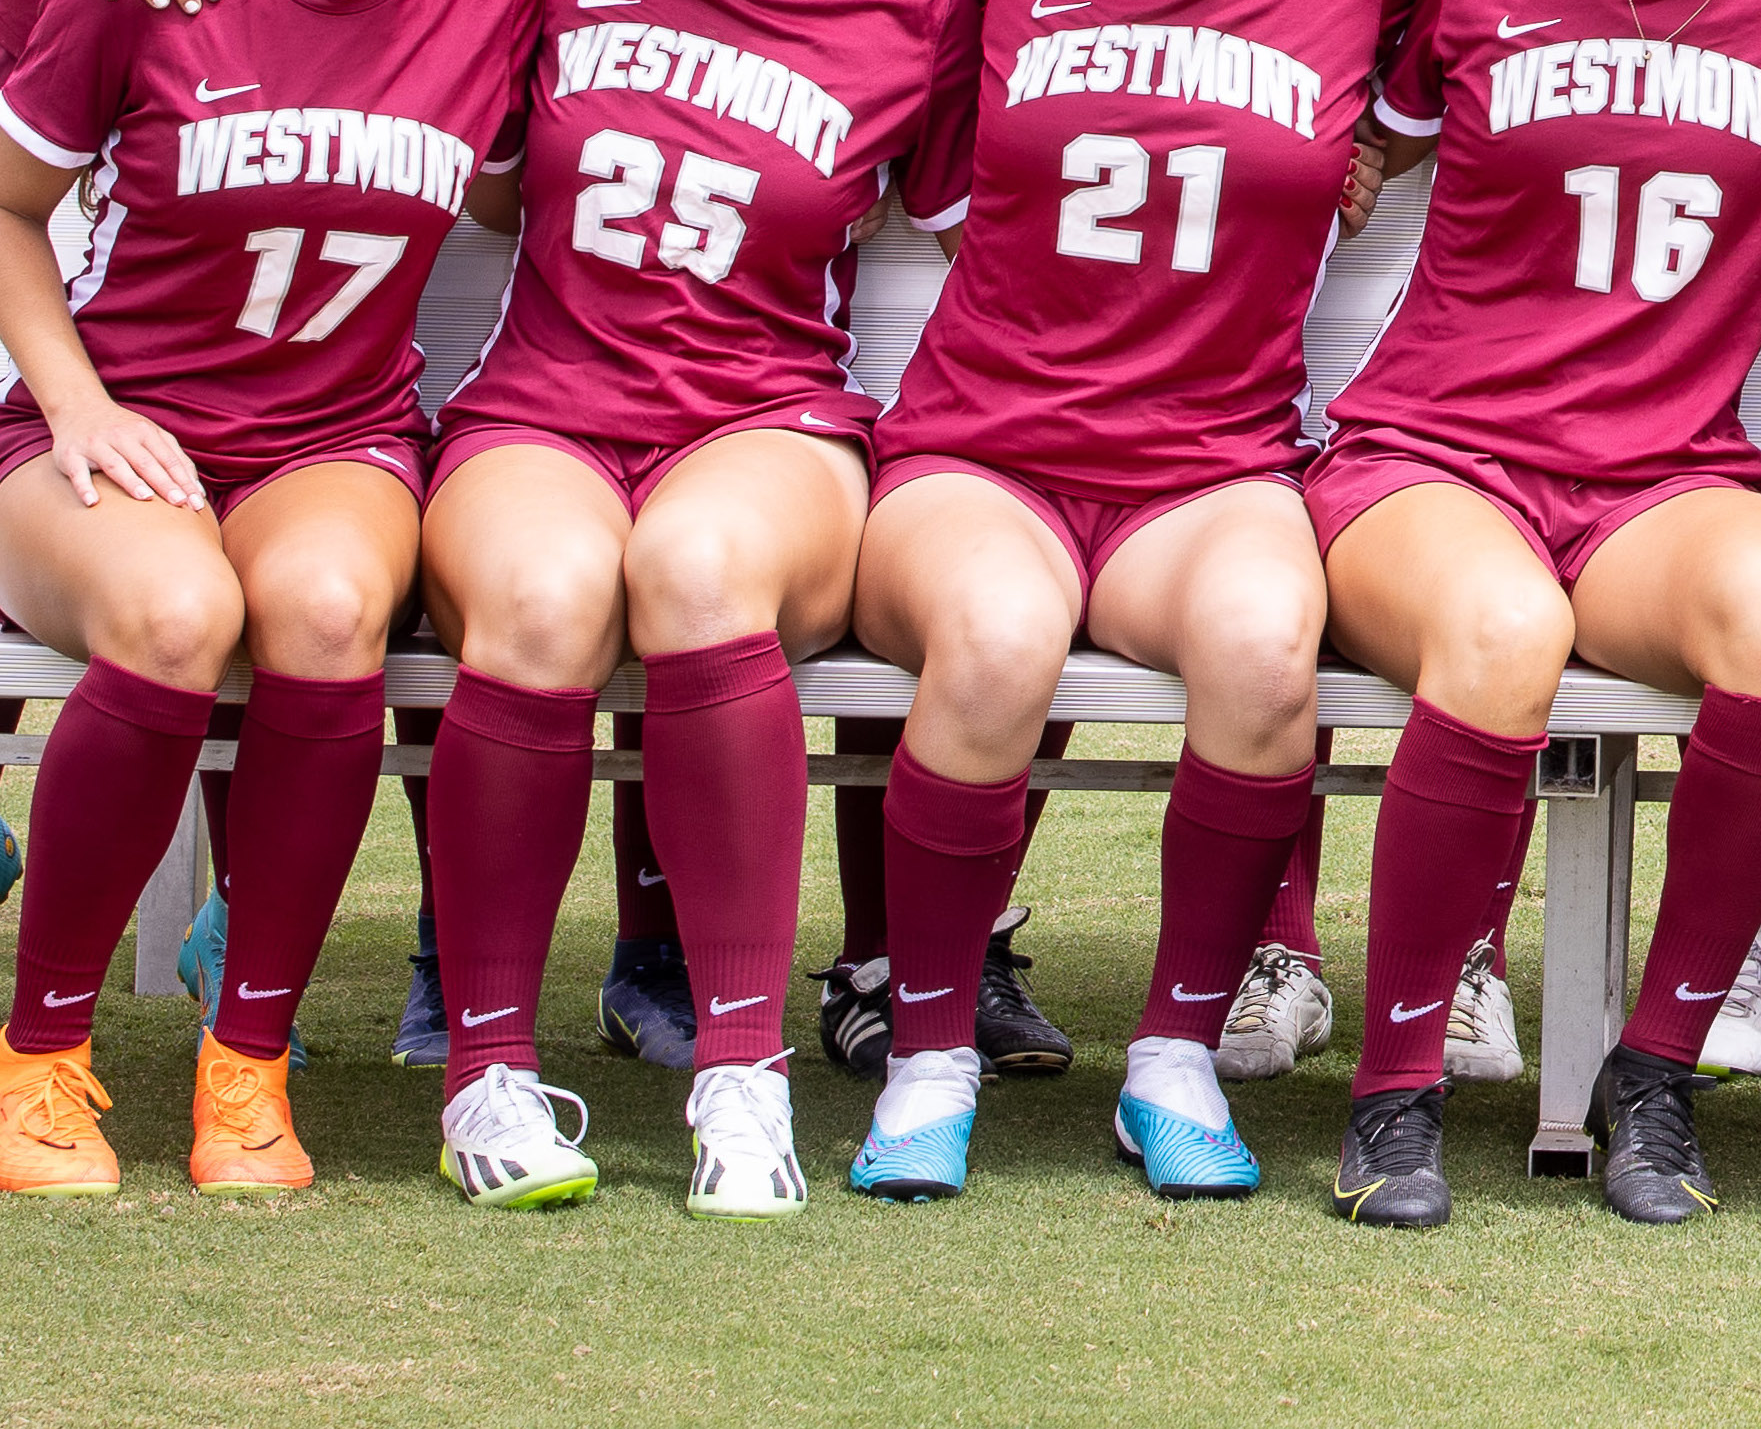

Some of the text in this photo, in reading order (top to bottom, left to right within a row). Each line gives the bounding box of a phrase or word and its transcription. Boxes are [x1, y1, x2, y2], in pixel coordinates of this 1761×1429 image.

[554, 21, 854, 178] WESTMONT
[1005, 23, 1321, 141] WESTMONT
[177, 107, 475, 218] WESTMONT
[572, 128, 760, 286] 25
[1055, 132, 1227, 273] 21
[236, 226, 408, 343] 17
[1564, 164, 1722, 303] 16
